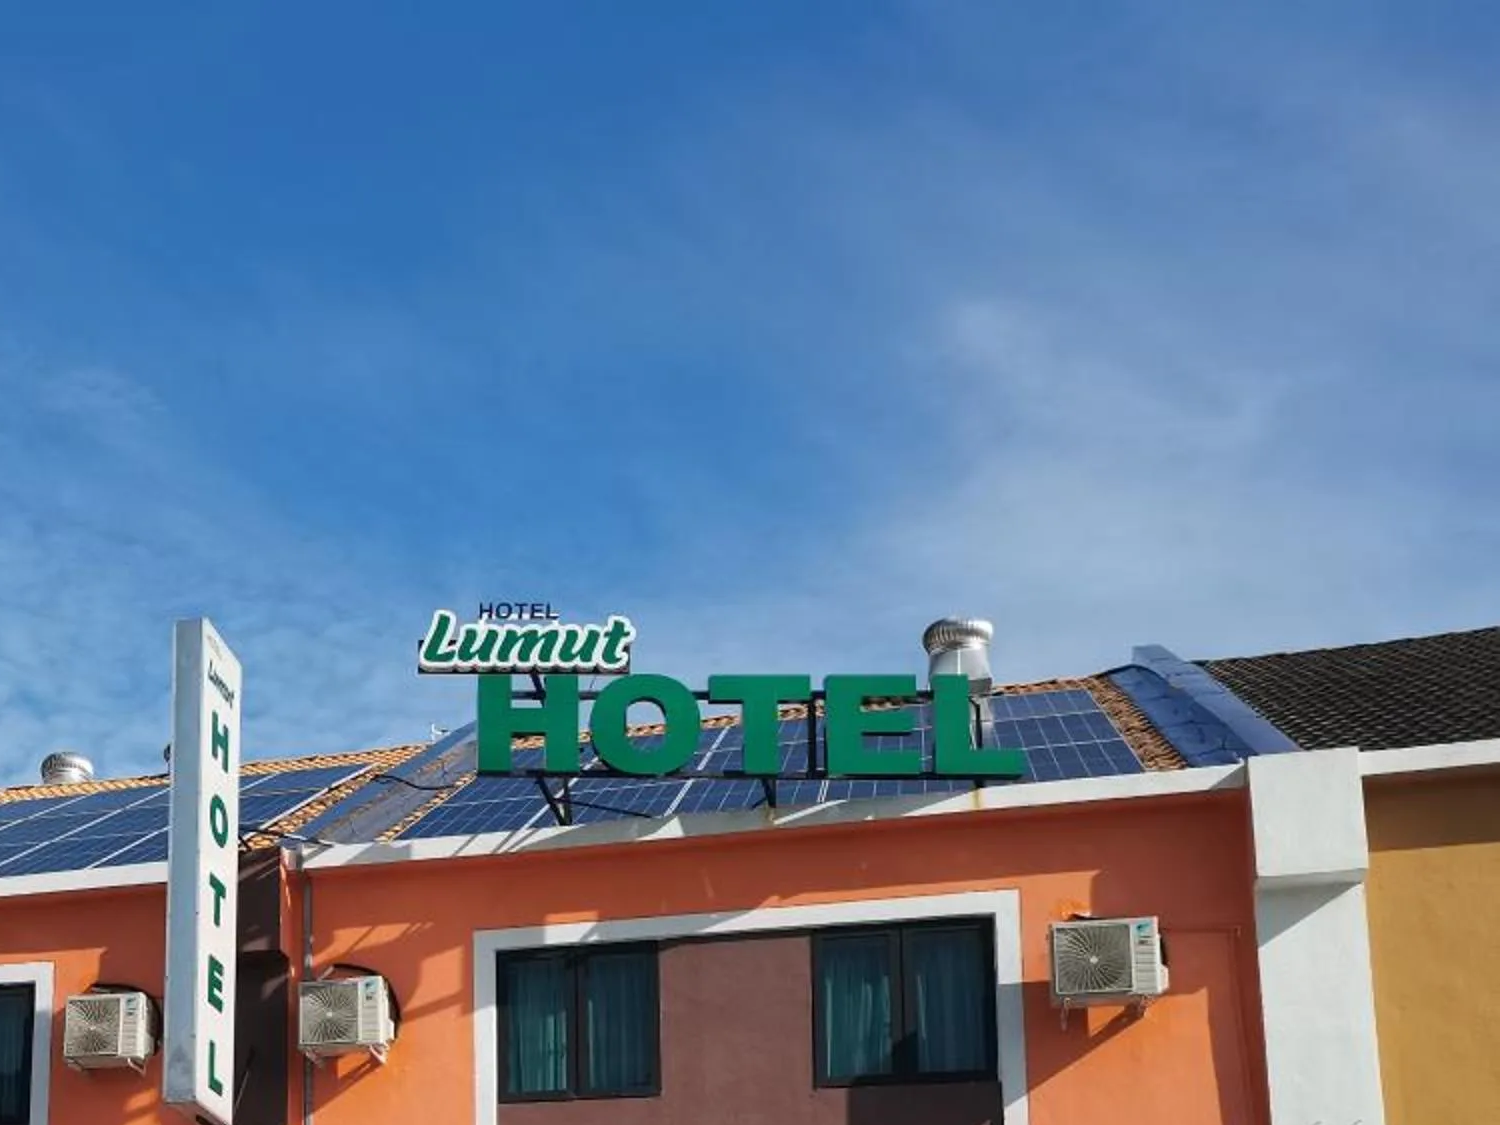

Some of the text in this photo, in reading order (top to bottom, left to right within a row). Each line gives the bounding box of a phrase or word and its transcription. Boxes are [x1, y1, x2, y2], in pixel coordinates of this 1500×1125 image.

[421, 611, 635, 669] Lumut
[478, 601, 559, 621] HOTEL
[476, 673, 1024, 776] HOTEL
[206, 709, 231, 1097] HOTEL
